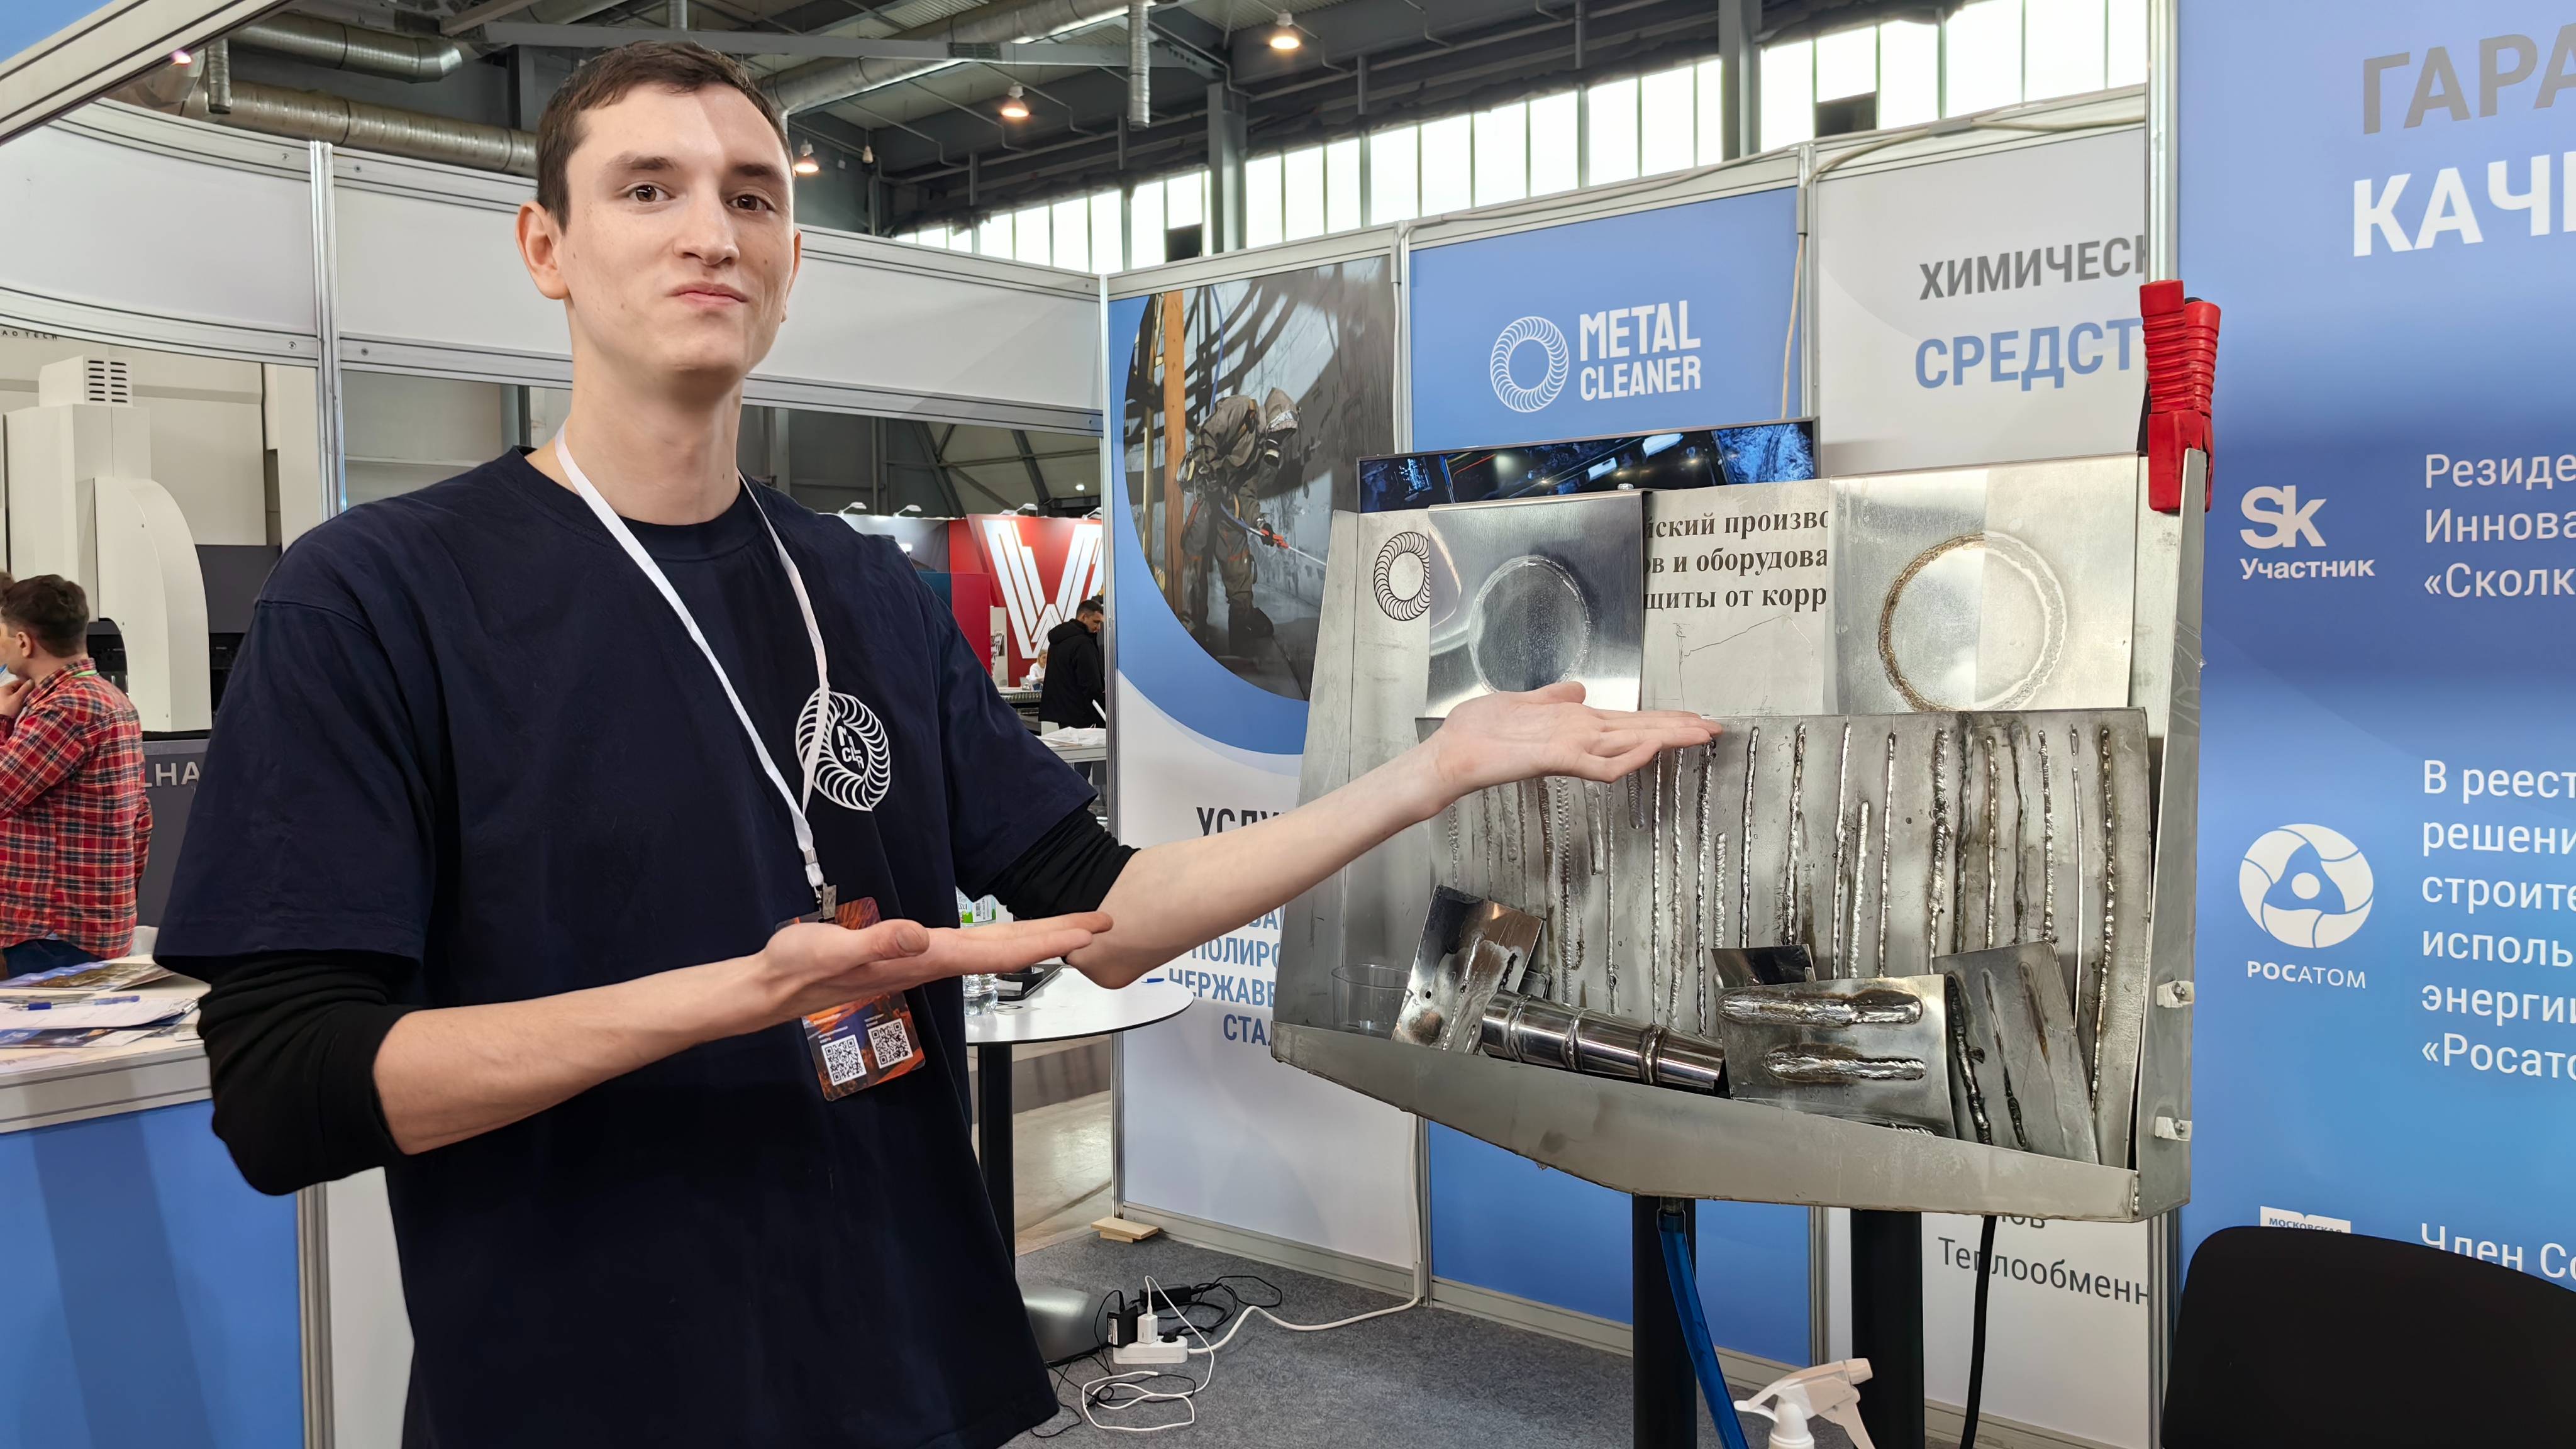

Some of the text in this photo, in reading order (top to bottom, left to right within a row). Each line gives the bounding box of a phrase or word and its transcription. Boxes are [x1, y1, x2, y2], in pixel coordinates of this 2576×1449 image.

[1579, 300, 1701, 362] METAL
[1916, 317, 2143, 391] СРЕДСТ
[1580, 355, 1701, 401] CLEANER
[2426, 453, 2576, 490] Резиде
[2240, 485, 2327, 549] Sk
[1673, 556, 1688, 572] и
[2240, 558, 2376, 580] Участник
[2424, 563, 2576, 598] «Сколк
[1725, 590, 1754, 608] от
[1761, 587, 1827, 613] корр
[2424, 760, 2447, 794] В
[2423, 930, 2573, 967] исполь
[2247, 960, 2367, 989] РОСАТОМ
[2422, 984, 2576, 1026] энерги
[1223, 1014, 1271, 1046] СТА
[2421, 1223, 2523, 1272] Член
